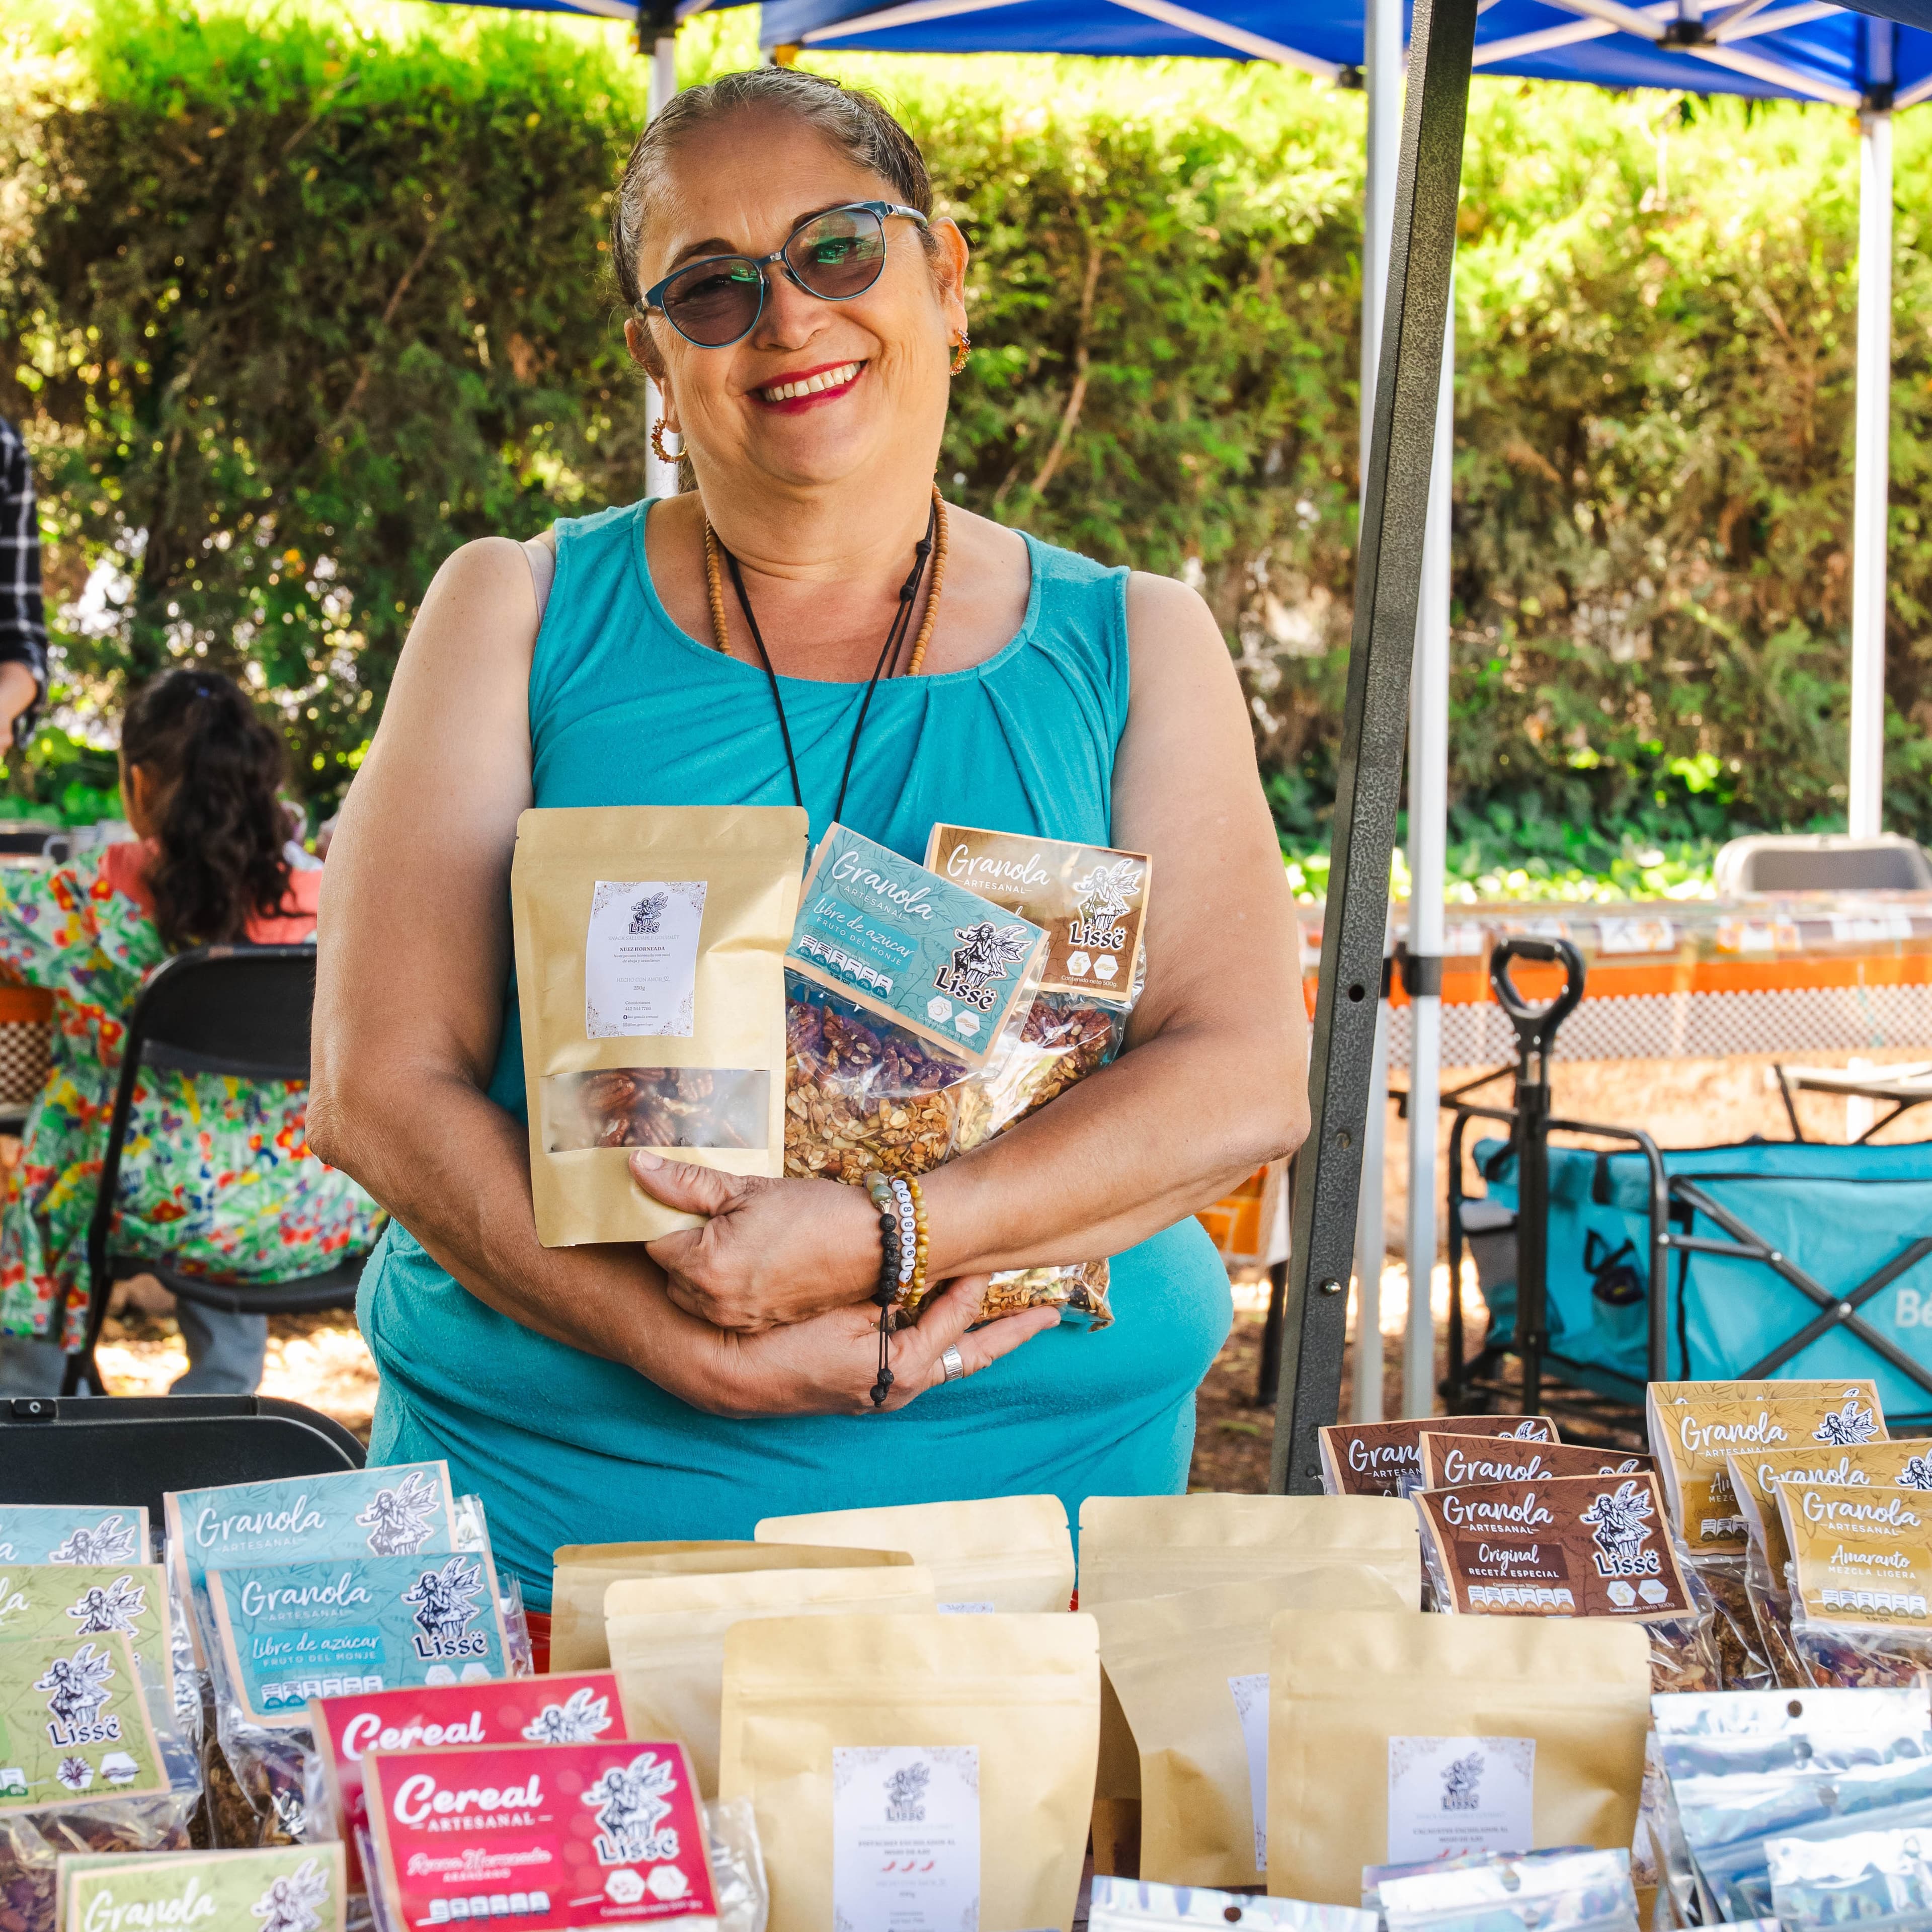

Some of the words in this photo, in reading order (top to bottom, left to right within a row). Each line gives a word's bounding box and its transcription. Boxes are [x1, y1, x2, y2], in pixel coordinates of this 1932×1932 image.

[947, 844, 1050, 885] Granola
[832, 851, 933, 920] Granola
[963, 879, 1025, 894] ARTESANAL
[844, 886, 903, 919] ARTESANAL
[629, 922, 660, 934] Lissë
[814, 898, 845, 923] Libre
[847, 916, 864, 932] de
[866, 930, 915, 957] azúcar
[817, 917, 846, 936] FRUTO
[849, 935, 866, 947] DEL
[871, 945, 902, 965] MONJE
[1071, 923, 1124, 949] Lissë
[830, 963, 840, 972] 15%
[1061, 975, 1089, 983] Contenido
[935, 967, 995, 1010] Lissë
[918, 1014, 947, 1031] Contenido
[948, 1028, 960, 1038] neto
[1681, 1412, 1788, 1451] Granola
[1758, 1457, 1870, 1493] Granola
[196, 1495, 327, 1548] Granola
[1443, 1492, 1554, 1525] Granola
[1803, 1492, 1921, 1526] Granola
[1469, 1523, 1534, 1535] ARTESANAL
[1828, 1523, 1899, 1536] ARTESANAL
[221, 1537, 299, 1553] ARTESANAL
[1479, 1543, 1540, 1571] Original
[1831, 1544, 1910, 1569] Amaranto
[1469, 1567, 1506, 1577] RECETA
[1511, 1569, 1560, 1579] ESPECIAL
[1595, 1551, 1659, 1575] Lissë
[1828, 1566, 1872, 1576] MEZCLA
[1877, 1570, 1916, 1579] LIGERA
[241, 1572, 373, 1617] Granola
[269, 1608, 345, 1621] ARTESANAL
[253, 1636, 293, 1659] Libre
[296, 1632, 318, 1651] de
[320, 1635, 380, 1651] azúcar
[263, 1656, 303, 1667] FRUTO
[309, 1654, 331, 1663] DEL
[336, 1651, 376, 1660] MONJE
[415, 1634, 489, 1659] Lissë
[49, 1715, 120, 1746] Lissë
[342, 1711, 486, 1760] Cereal
[393, 1774, 544, 1825] Cereal
[427, 1811, 535, 1833] ARTESANAL
[597, 1830, 679, 1863] Lissë
[84, 1876, 218, 1932] Granola
